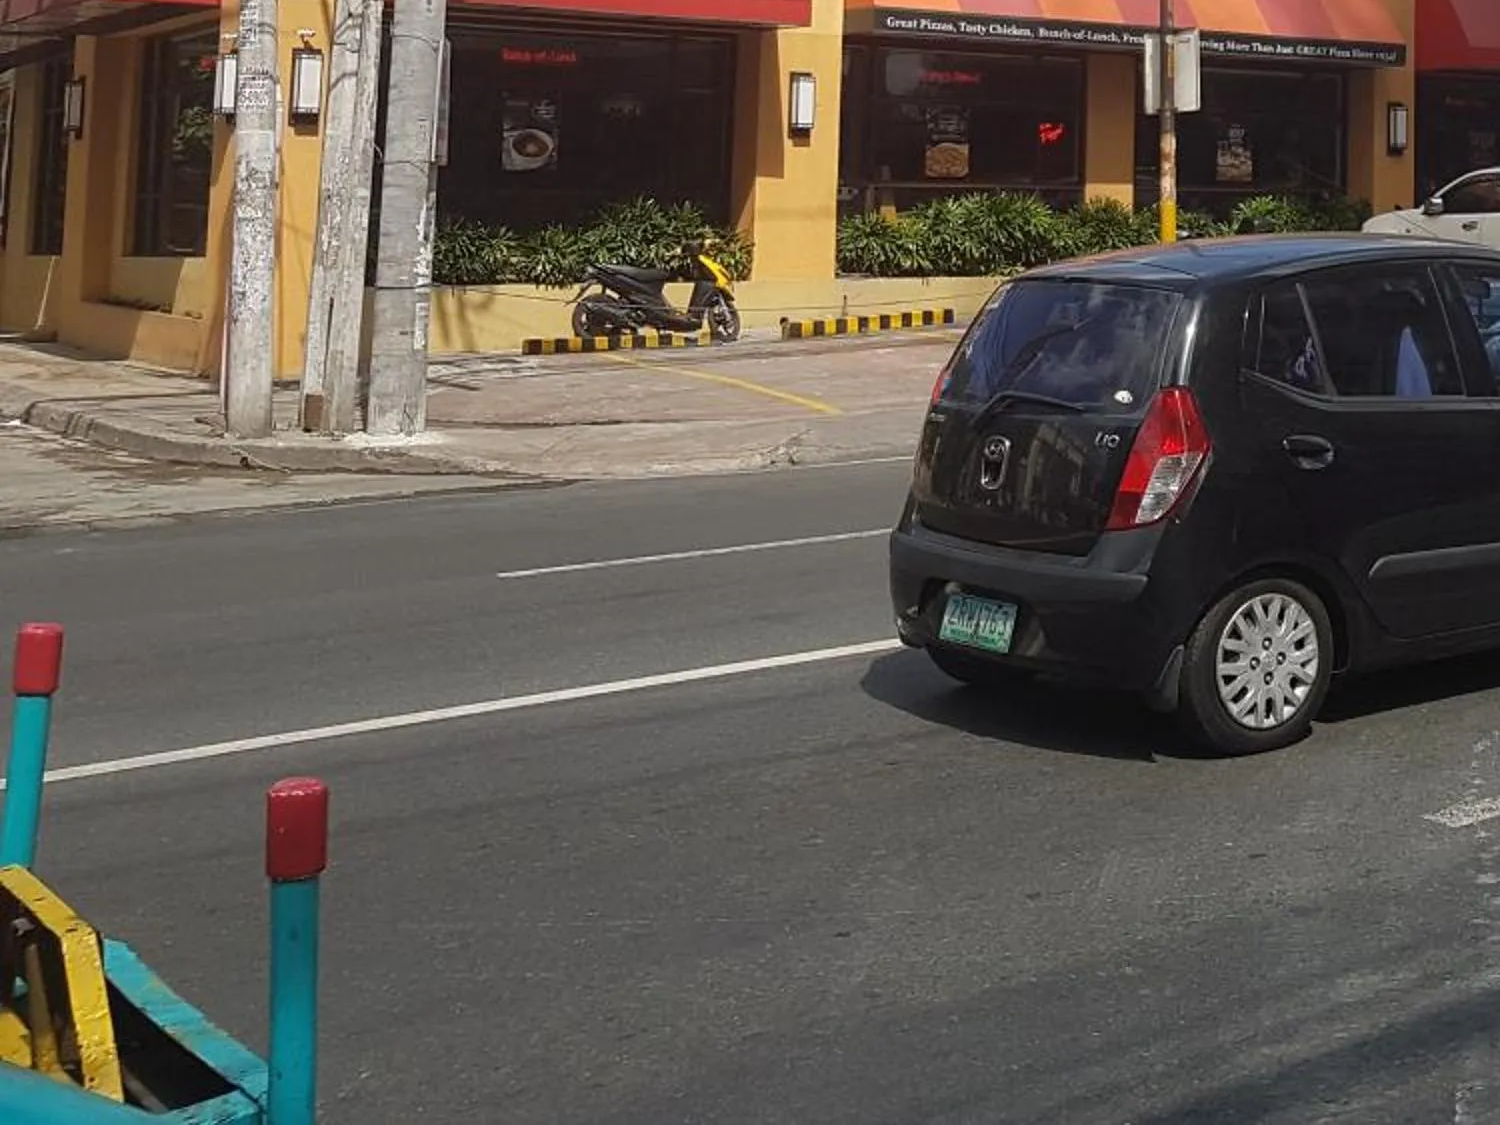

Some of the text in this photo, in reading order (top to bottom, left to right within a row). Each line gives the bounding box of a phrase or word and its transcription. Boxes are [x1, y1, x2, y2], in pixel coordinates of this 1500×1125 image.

[886, 15, 918, 29] Great
[920, 18, 957, 34] Pizzas,
[959, 21, 987, 36] Tasty
[989, 23, 1035, 38] Chicken,
[1251, 41, 1275, 54] Than
